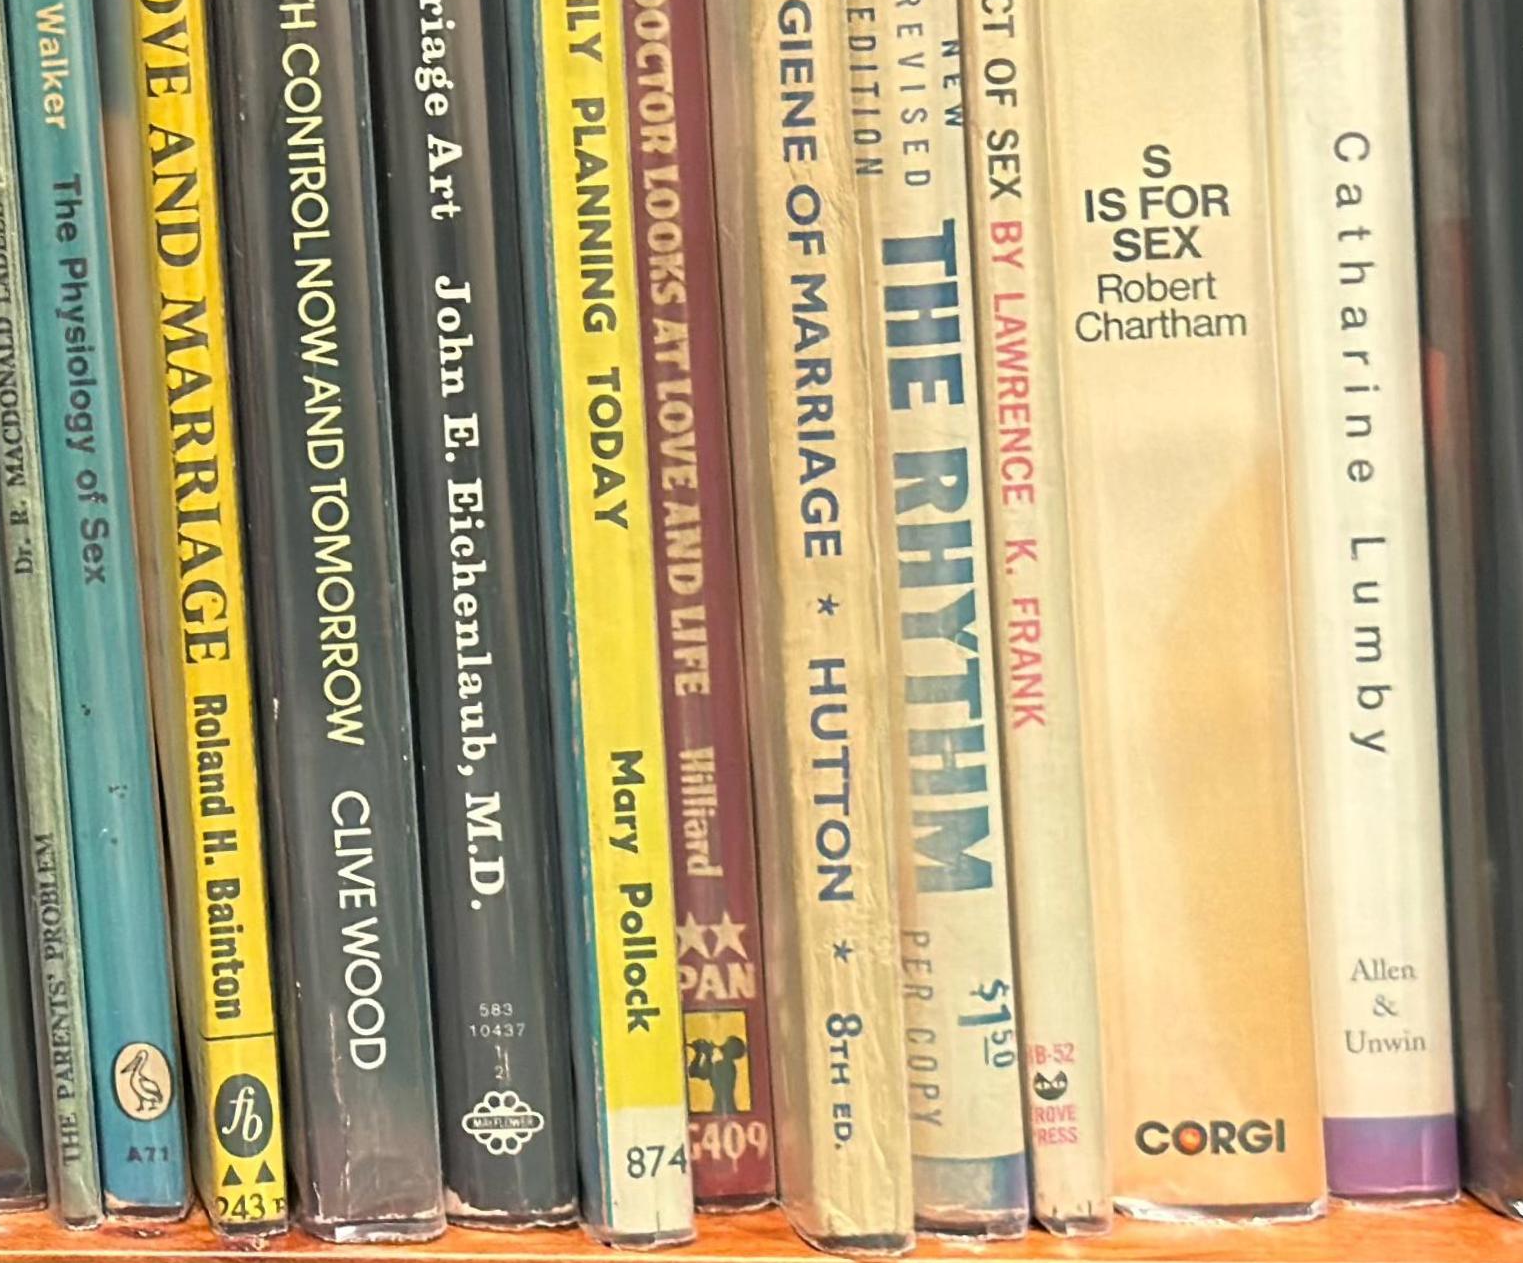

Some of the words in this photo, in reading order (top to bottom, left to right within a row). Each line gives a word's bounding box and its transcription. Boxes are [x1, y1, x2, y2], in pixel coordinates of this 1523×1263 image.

[34, 4, 66, 129] Walker
[150, 124, 203, 269] AND
[1143, 144, 1171, 177] S
[53, 172, 81, 243] The
[571, 96, 619, 333] PLANNING
[784, 184, 825, 257] OF
[1084, 191, 1125, 222] IS
[1141, 185, 1229, 219] FOR
[1113, 227, 1202, 261] SEX
[1097, 272, 1216, 304] Robert
[1333, 130, 1374, 485] Catharine
[58, 254, 96, 456] Physiology
[1075, 309, 1247, 342] Chartham
[588, 366, 627, 530] TODAY
[790, 274, 842, 560] MARRIAGE
[78, 471, 103, 505] of
[161, 296, 230, 664] MARRIAGE
[81, 517, 106, 586] Sex
[1350, 536, 1391, 754] Lumby
[193, 693, 234, 817] Roland
[806, 659, 852, 902] HUTTON
[610, 749, 643, 854] Mary
[205, 829, 238, 865] H.
[205, 876, 241, 1020] Bainton
[619, 884, 656, 1032] Pollock
[1350, 958, 1416, 982] Allen
[1372, 994, 1397, 1016] &
[1344, 1030, 1426, 1054] Unwin
[127, 1147, 168, 1163] A71
[626, 1146, 688, 1179] 874
[1135, 1119, 1285, 1156] CORGI
